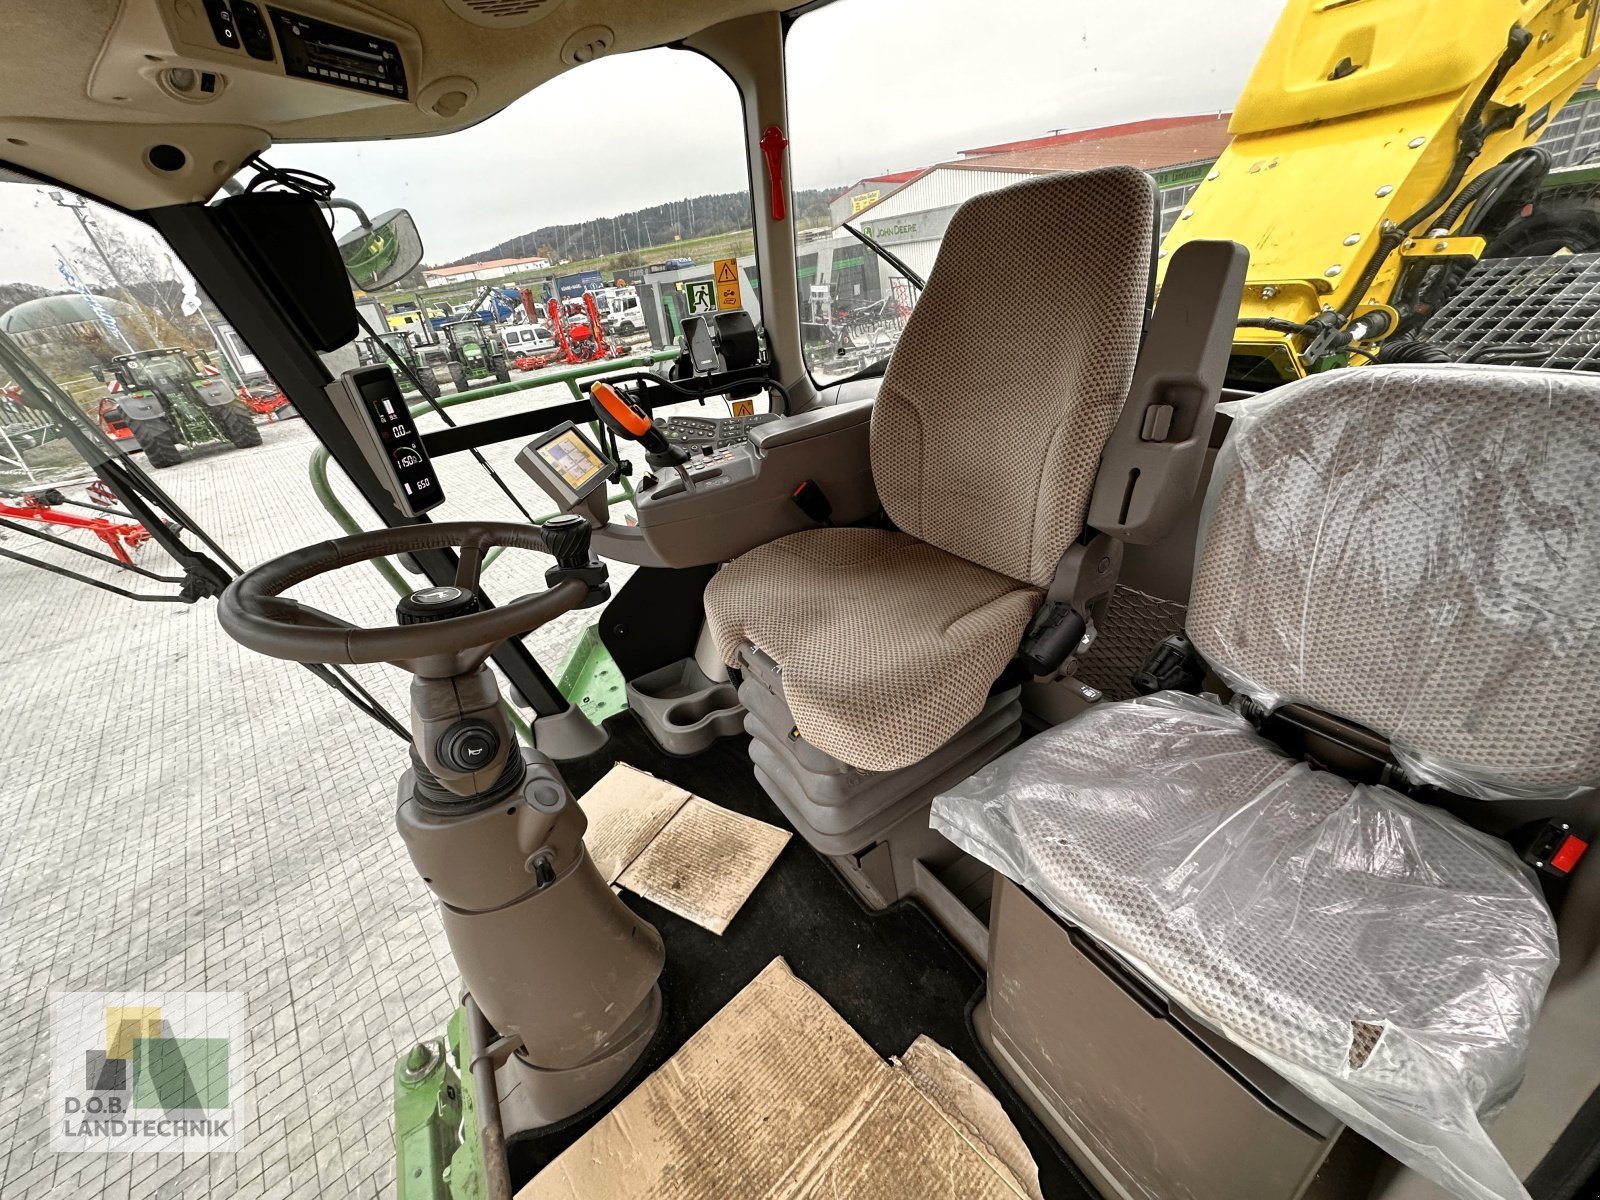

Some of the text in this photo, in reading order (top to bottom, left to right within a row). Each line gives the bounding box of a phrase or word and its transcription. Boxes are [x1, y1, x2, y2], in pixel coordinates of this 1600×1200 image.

[876, 223, 917, 238] JOHN DEERE
[392, 424, 406, 438] 0.0
[416, 477, 430, 490] 650
